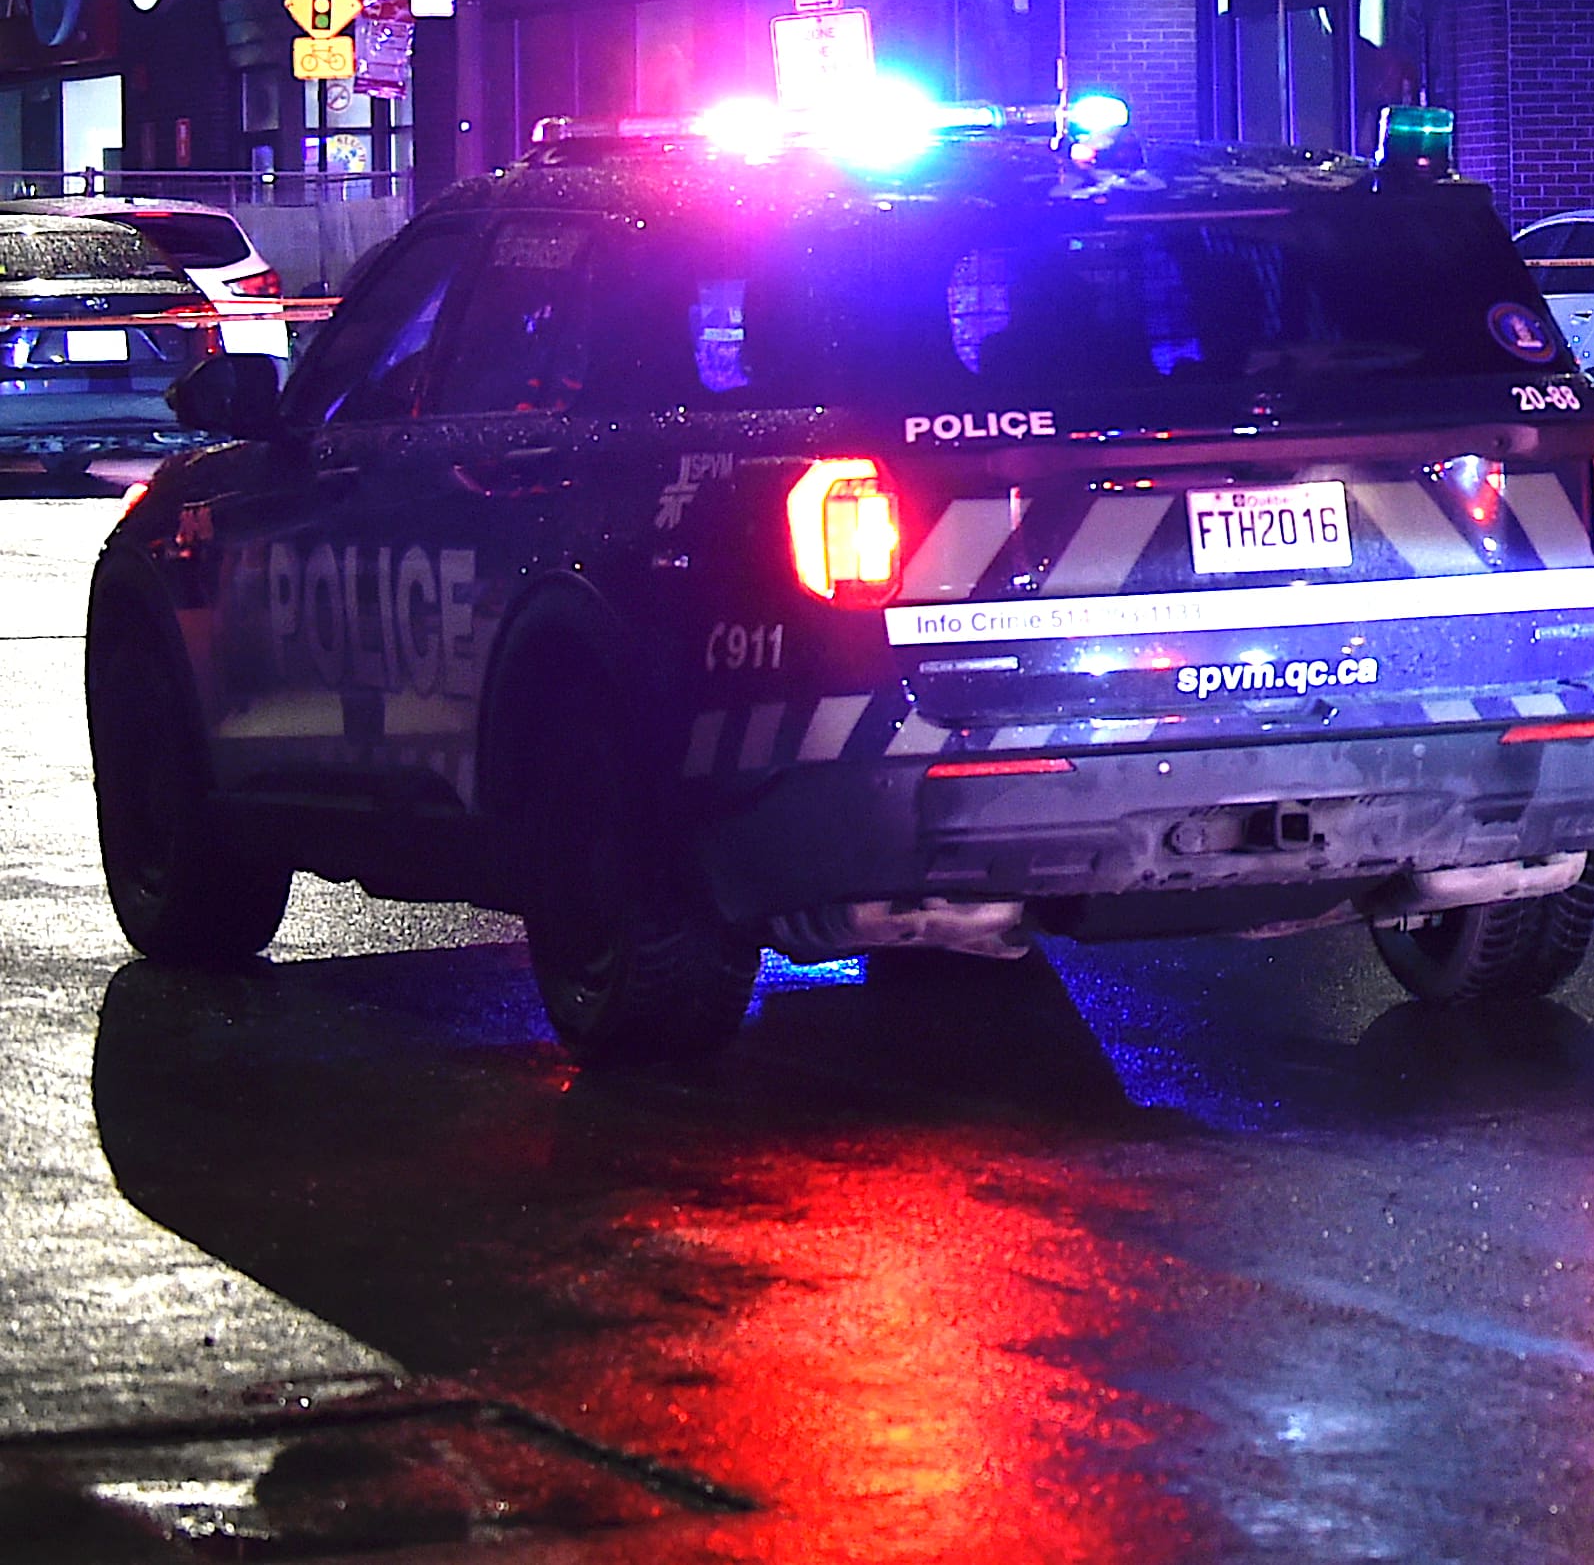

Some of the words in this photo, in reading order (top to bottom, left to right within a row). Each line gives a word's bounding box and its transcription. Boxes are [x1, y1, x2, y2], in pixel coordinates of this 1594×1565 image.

[1511, 385, 1581, 411] 20-88
[903, 410, 1057, 444] POLICE
[1196, 507, 1338, 550] FTH2016
[269, 542, 478, 700] POLICE
[916, 614, 962, 634] Info
[726, 623, 785, 671] 911
[1176, 657, 1379, 699] spvm.qc.ca
